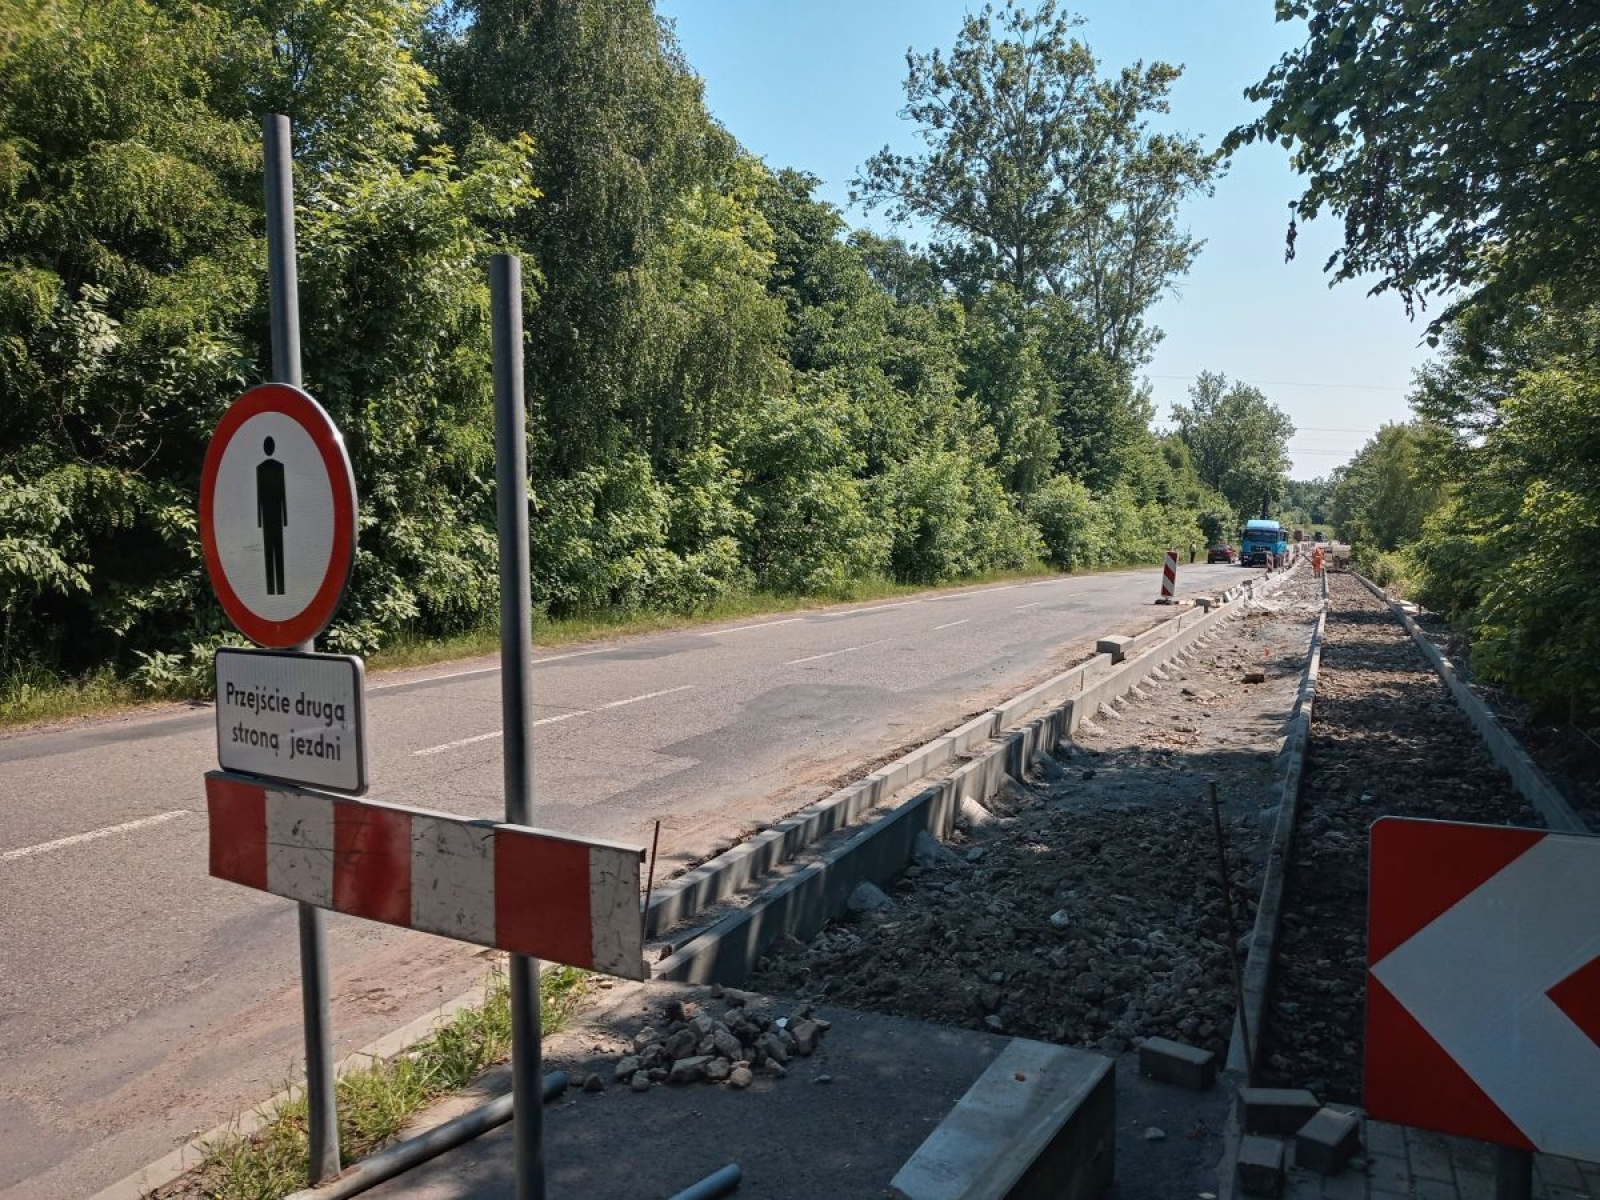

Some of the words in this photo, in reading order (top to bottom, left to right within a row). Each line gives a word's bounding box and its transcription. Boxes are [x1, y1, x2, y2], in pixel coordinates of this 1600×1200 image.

[226, 682, 290, 715] Przejście
[295, 692, 345, 730] drugą
[232, 721, 279, 756] stroną
[290, 729, 340, 760] jezdni
